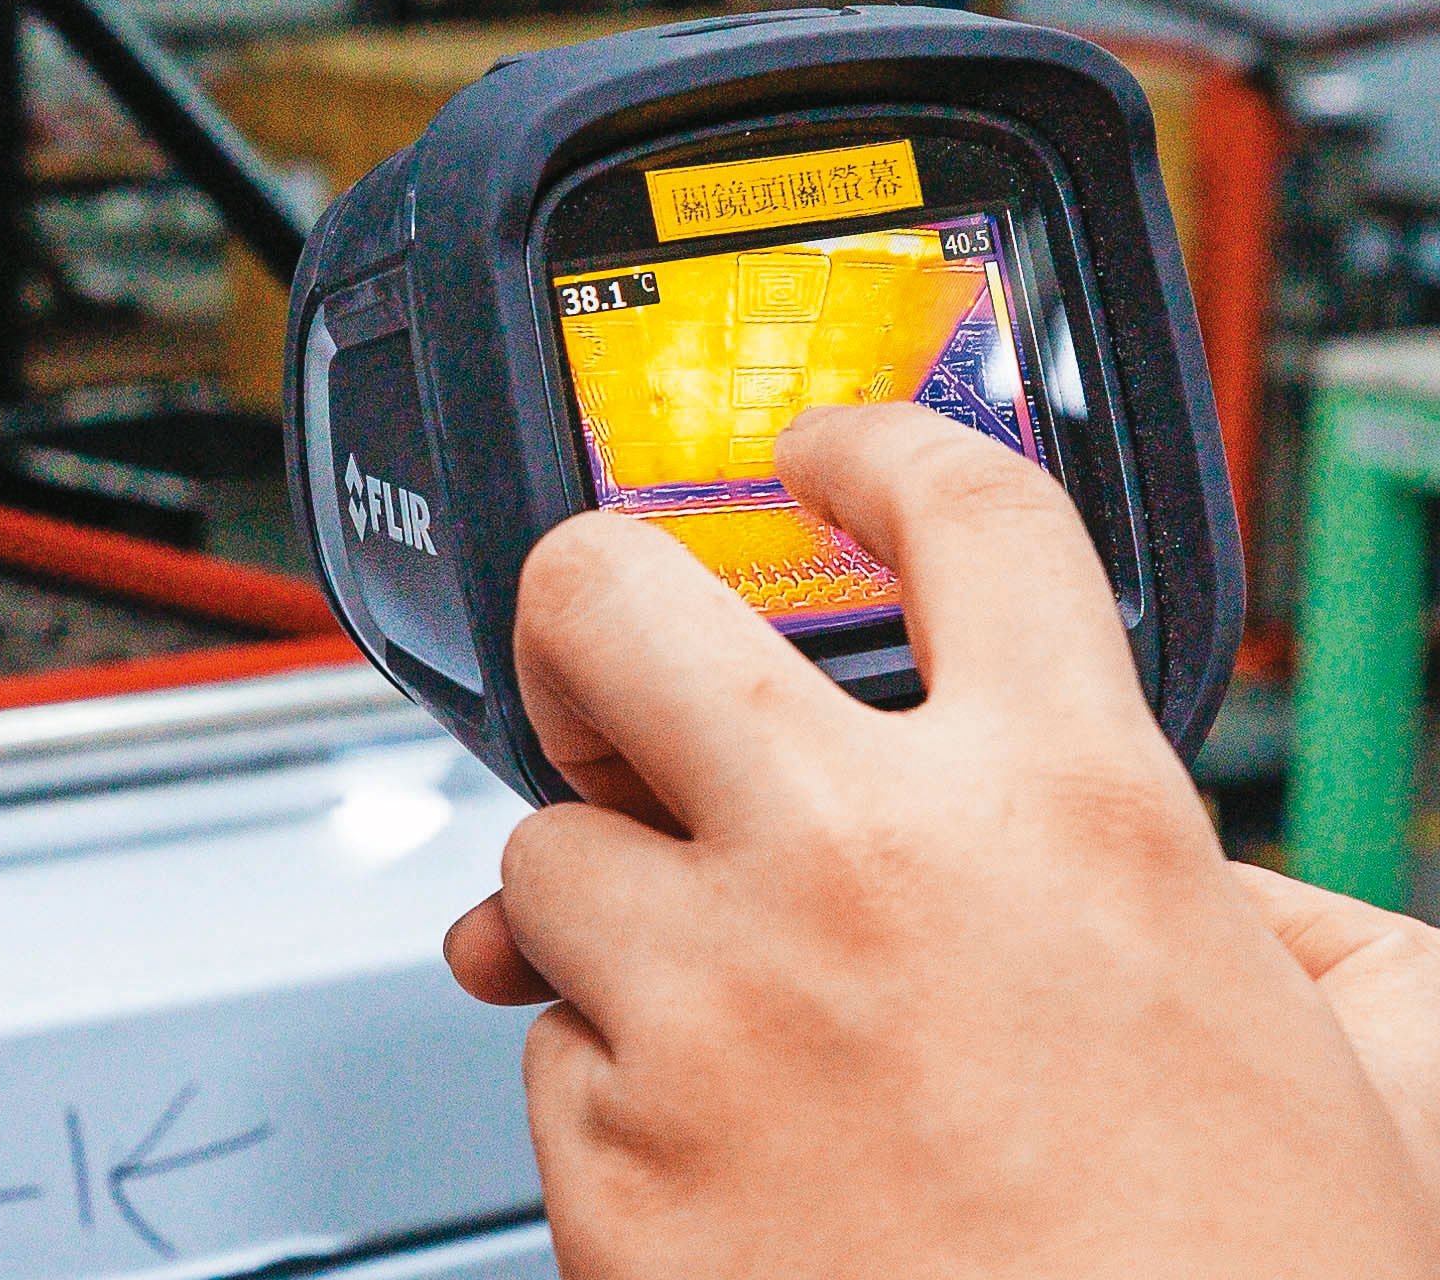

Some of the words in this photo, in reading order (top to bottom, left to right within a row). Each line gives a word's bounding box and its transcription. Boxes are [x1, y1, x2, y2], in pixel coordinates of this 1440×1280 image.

[671, 159, 904, 226] 關鏡頭關螢幕
[945, 230, 990, 255] 40.5
[562, 284, 626, 315] 38.1
[366, 475, 438, 556] FLIR
